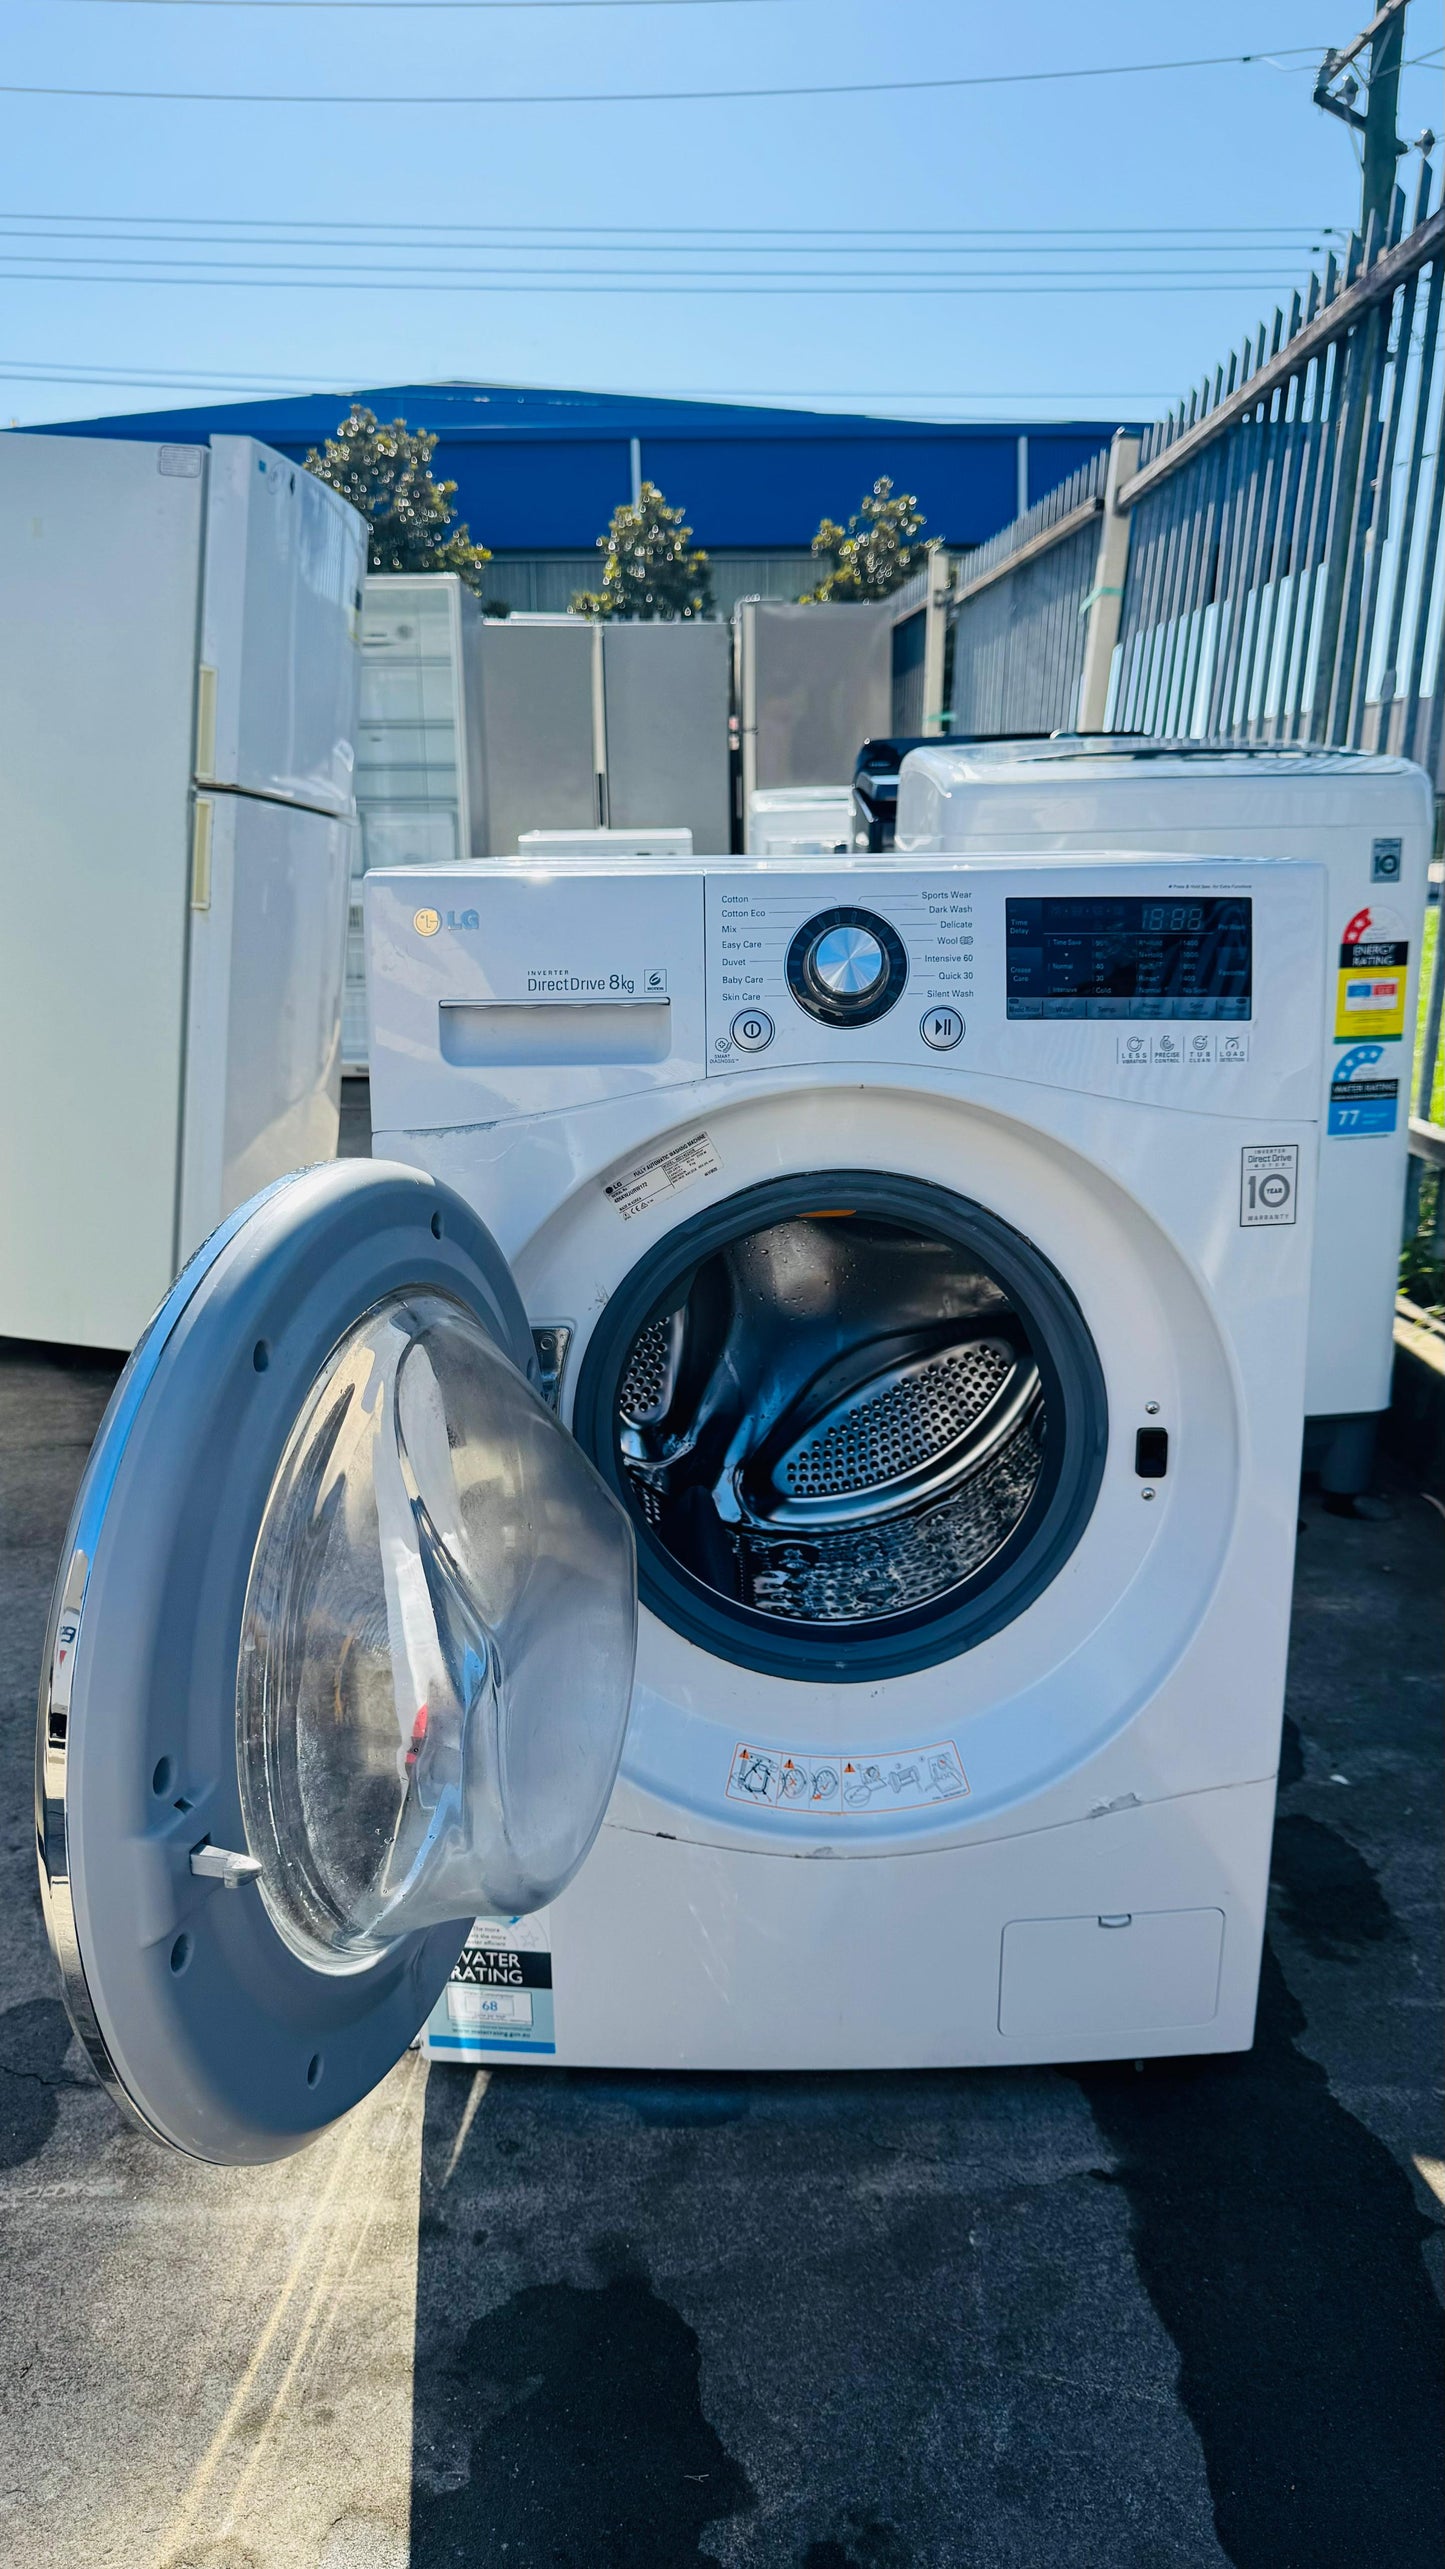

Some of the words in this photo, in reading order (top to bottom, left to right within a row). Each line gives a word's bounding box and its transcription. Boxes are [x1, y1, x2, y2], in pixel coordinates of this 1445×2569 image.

[722, 895, 748, 903] Cotton
[922, 892, 948, 900] Sports
[722, 910, 748, 918] Cotton
[447, 909, 480, 931] LG
[1010, 927, 1028, 935] Delay
[722, 940, 742, 949] Easy
[744, 940, 762, 948] Care
[1353, 944, 1395, 956] ENERGY
[924, 954, 961, 962] Intensive
[1352, 956, 1394, 966] RATING
[722, 976, 742, 984] Baby
[939, 972, 961, 980] Quick
[609, 974, 634, 993] 8kg
[927, 990, 948, 998] Silent
[951, 990, 974, 998] Wash
[1338, 1110, 1360, 1126] 77
[646, 1154, 670, 1170] AUTOMATIC
[669, 1144, 688, 1157] WASHING
[688, 1133, 706, 1146] MACHINE
[1248, 1174, 1290, 1208] 10
[450, 1967, 523, 1984] RATING
[482, 2001, 498, 2012] 68
